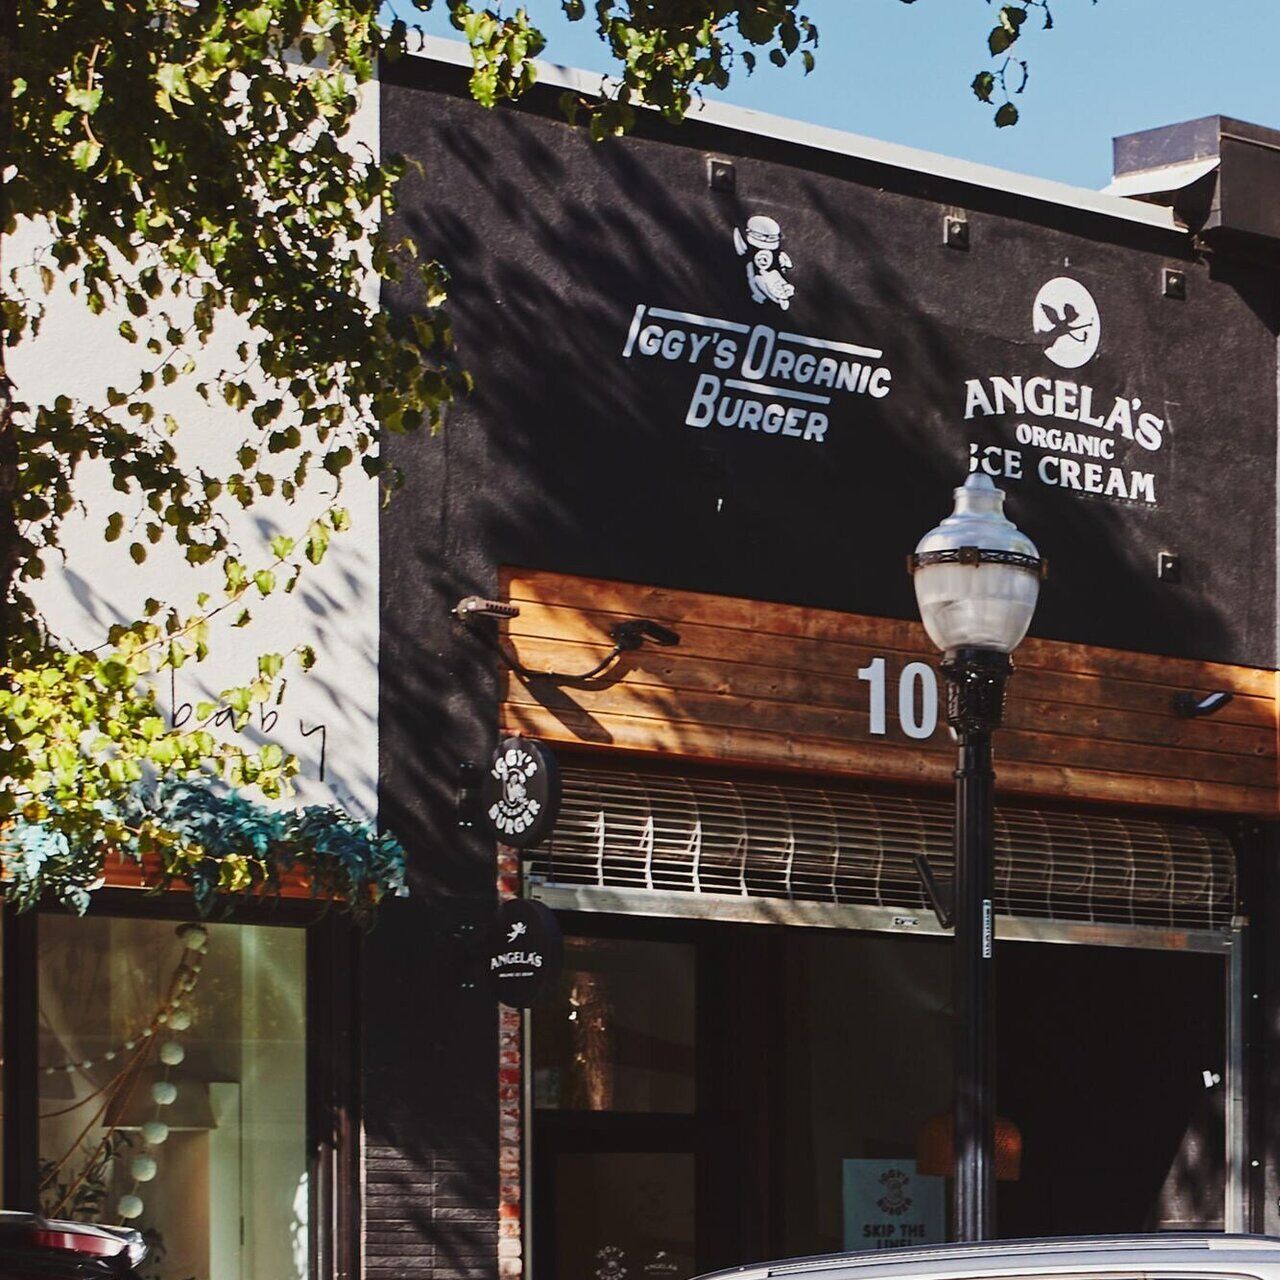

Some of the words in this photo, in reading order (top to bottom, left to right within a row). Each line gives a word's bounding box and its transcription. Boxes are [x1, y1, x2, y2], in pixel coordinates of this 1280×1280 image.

[622, 304, 738, 370] IGGY'S
[740, 325, 893, 399] ORGANIC
[685, 373, 830, 443] BURGER
[963, 375, 1165, 451] ANGELA'S
[1015, 423, 1115, 460] ORGANIC
[1037, 455, 1158, 503] CREAM
[857, 657, 958, 741] 10
[488, 799, 541, 835] BURGER
[863, 1223, 896, 1238] SKIP
[899, 1223, 926, 1238] THE
